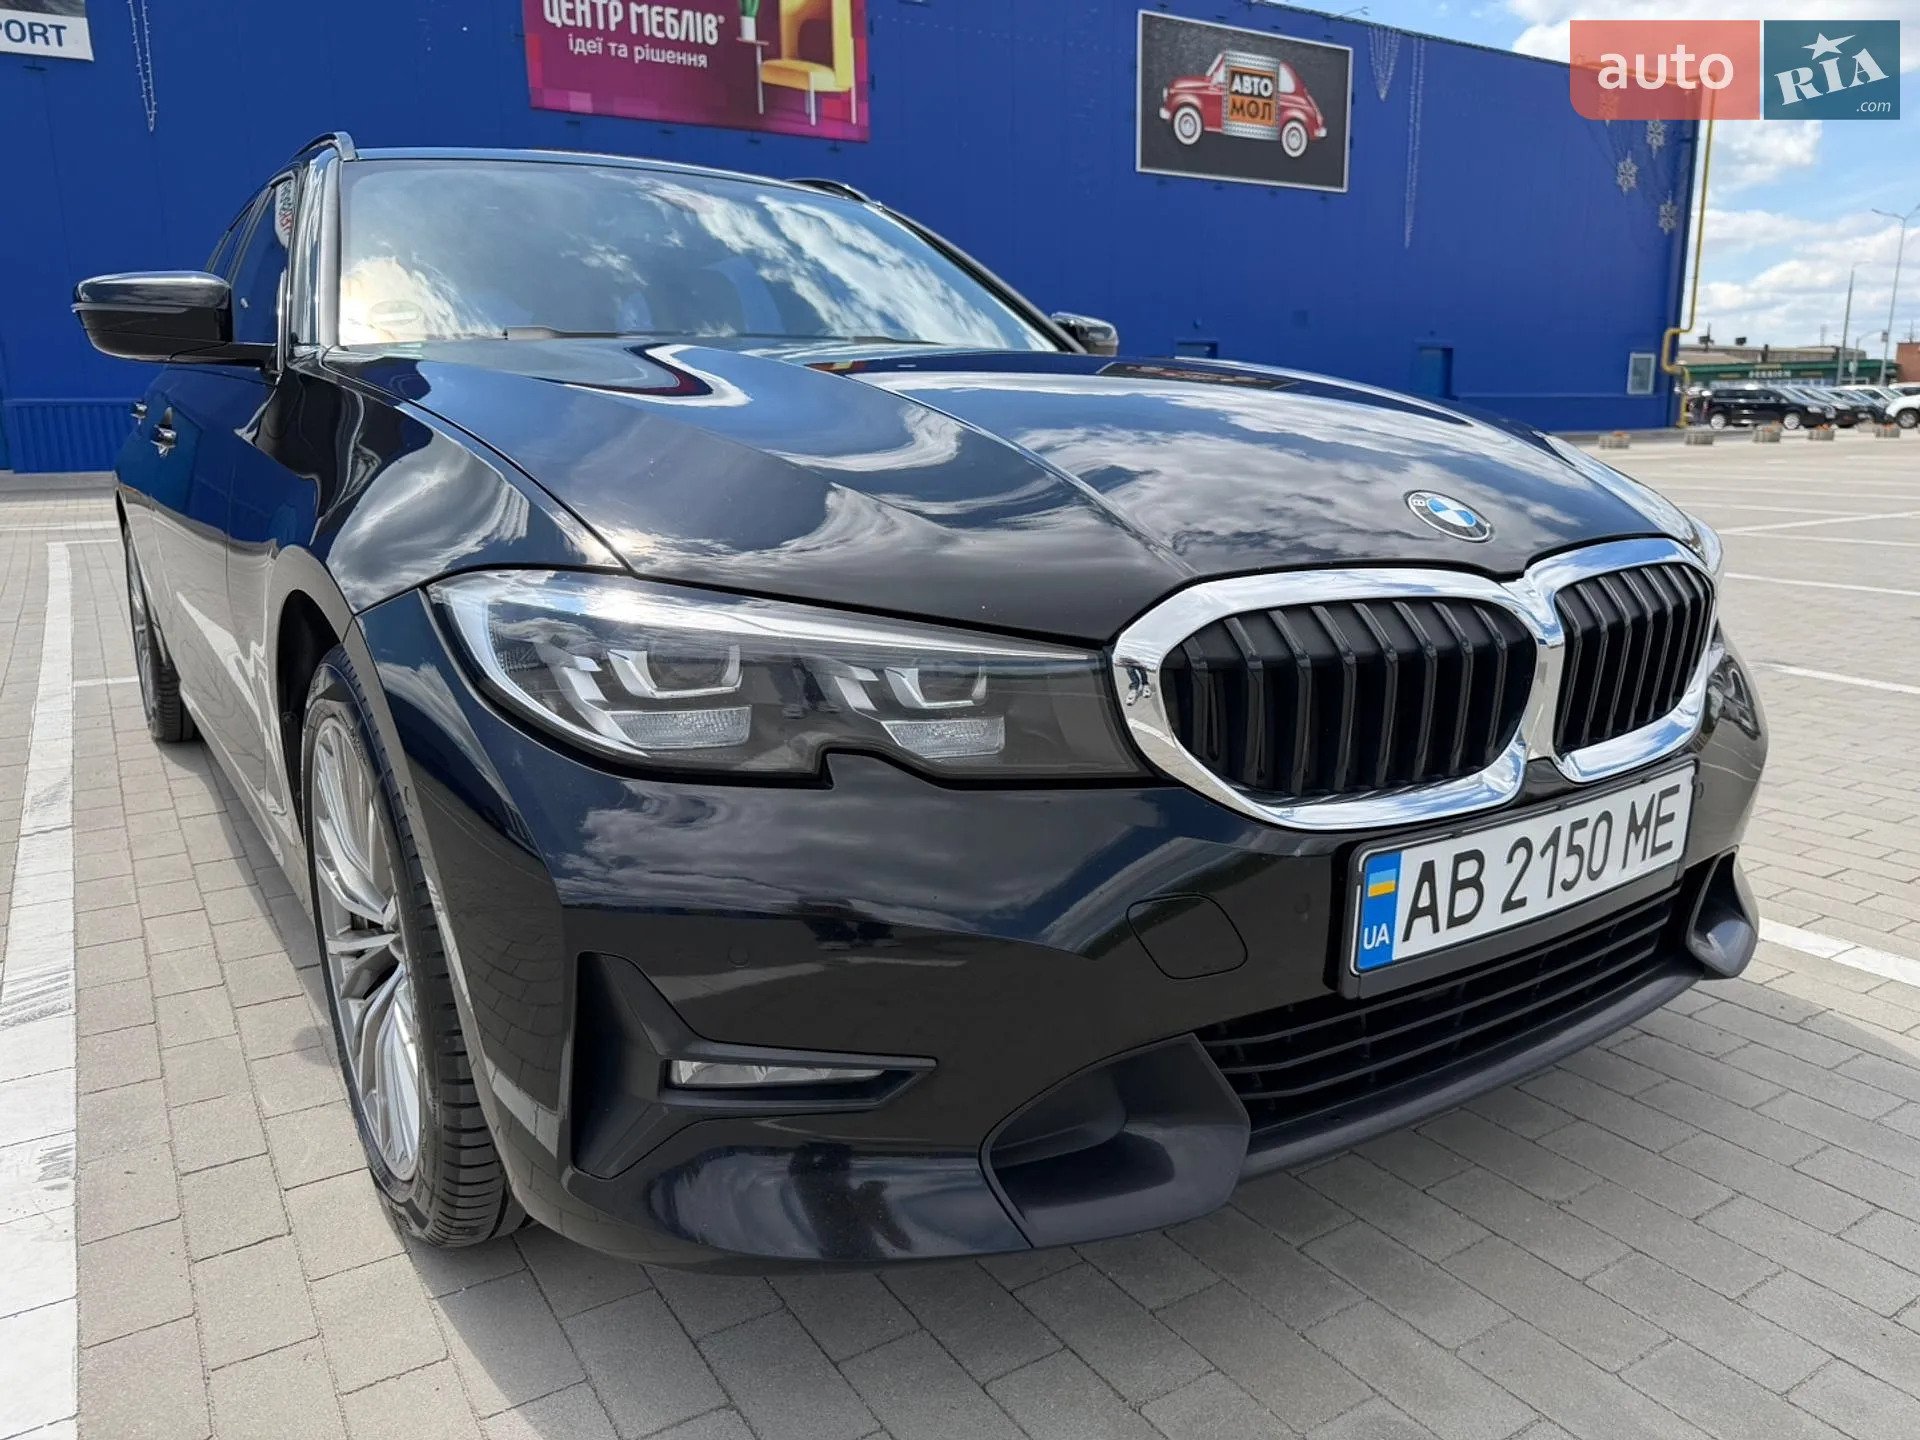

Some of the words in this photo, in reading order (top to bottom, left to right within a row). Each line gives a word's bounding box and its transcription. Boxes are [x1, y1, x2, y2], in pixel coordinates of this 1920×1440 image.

[0, 19, 67, 47] ORT
[568, 34, 603, 56] ідеї
[607, 41, 628, 58] та
[634, 44, 708, 68] рішення
[1231, 74, 1273, 97] АВТО
[1230, 101, 1272, 120] МОЛ
[1402, 849, 1485, 942] AB
[1501, 810, 1613, 914] 2150
[1621, 783, 1681, 869] ME
[1363, 922, 1390, 950] UA
